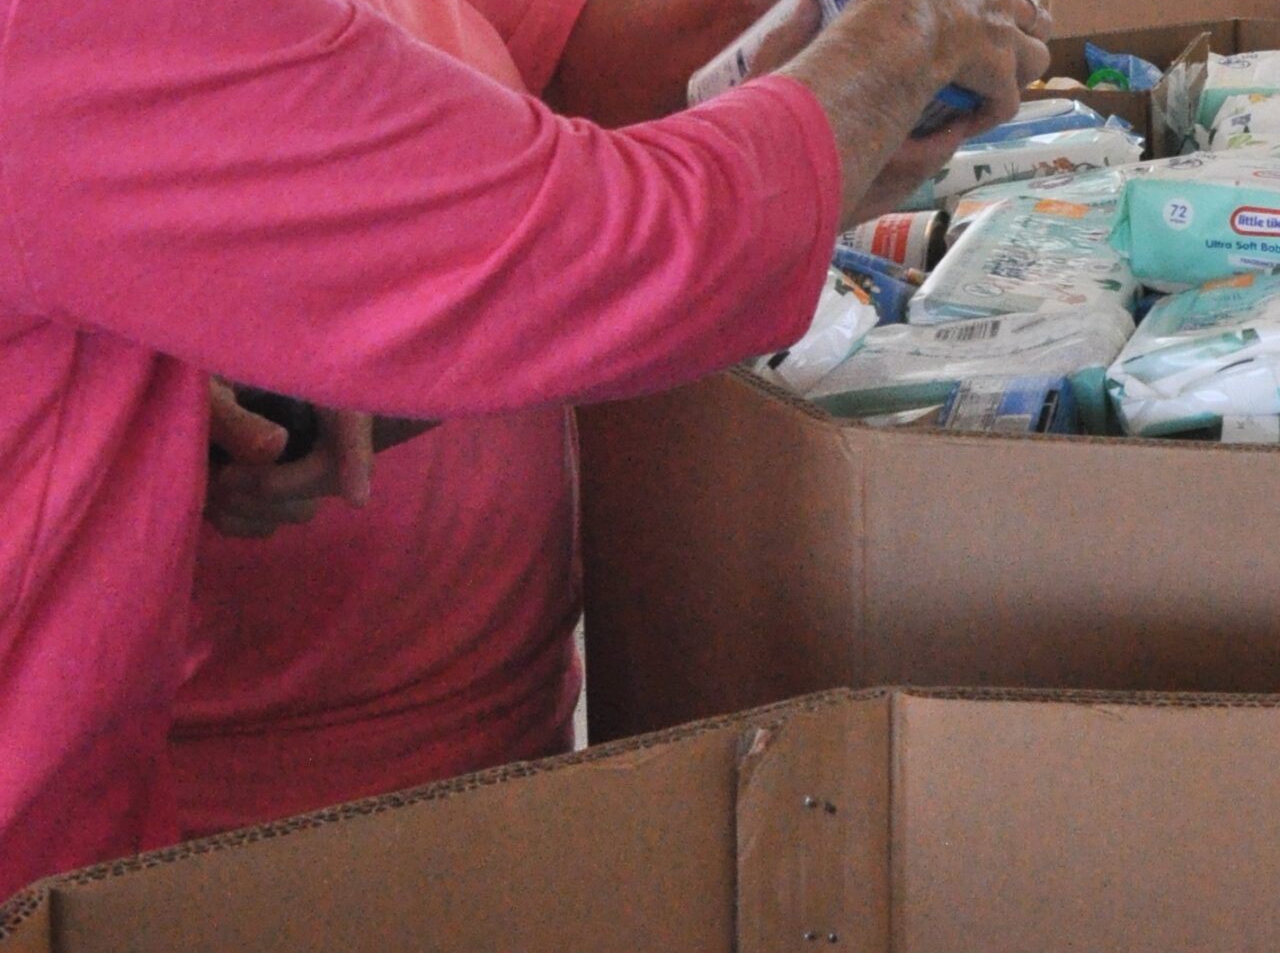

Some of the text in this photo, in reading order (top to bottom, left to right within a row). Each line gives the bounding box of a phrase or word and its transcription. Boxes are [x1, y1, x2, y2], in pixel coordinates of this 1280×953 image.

[1170, 203, 1188, 218] 72
[1238, 214, 1265, 228] little
[1205, 239, 1233, 250] Ultra
[1236, 241, 1258, 251] Soft
